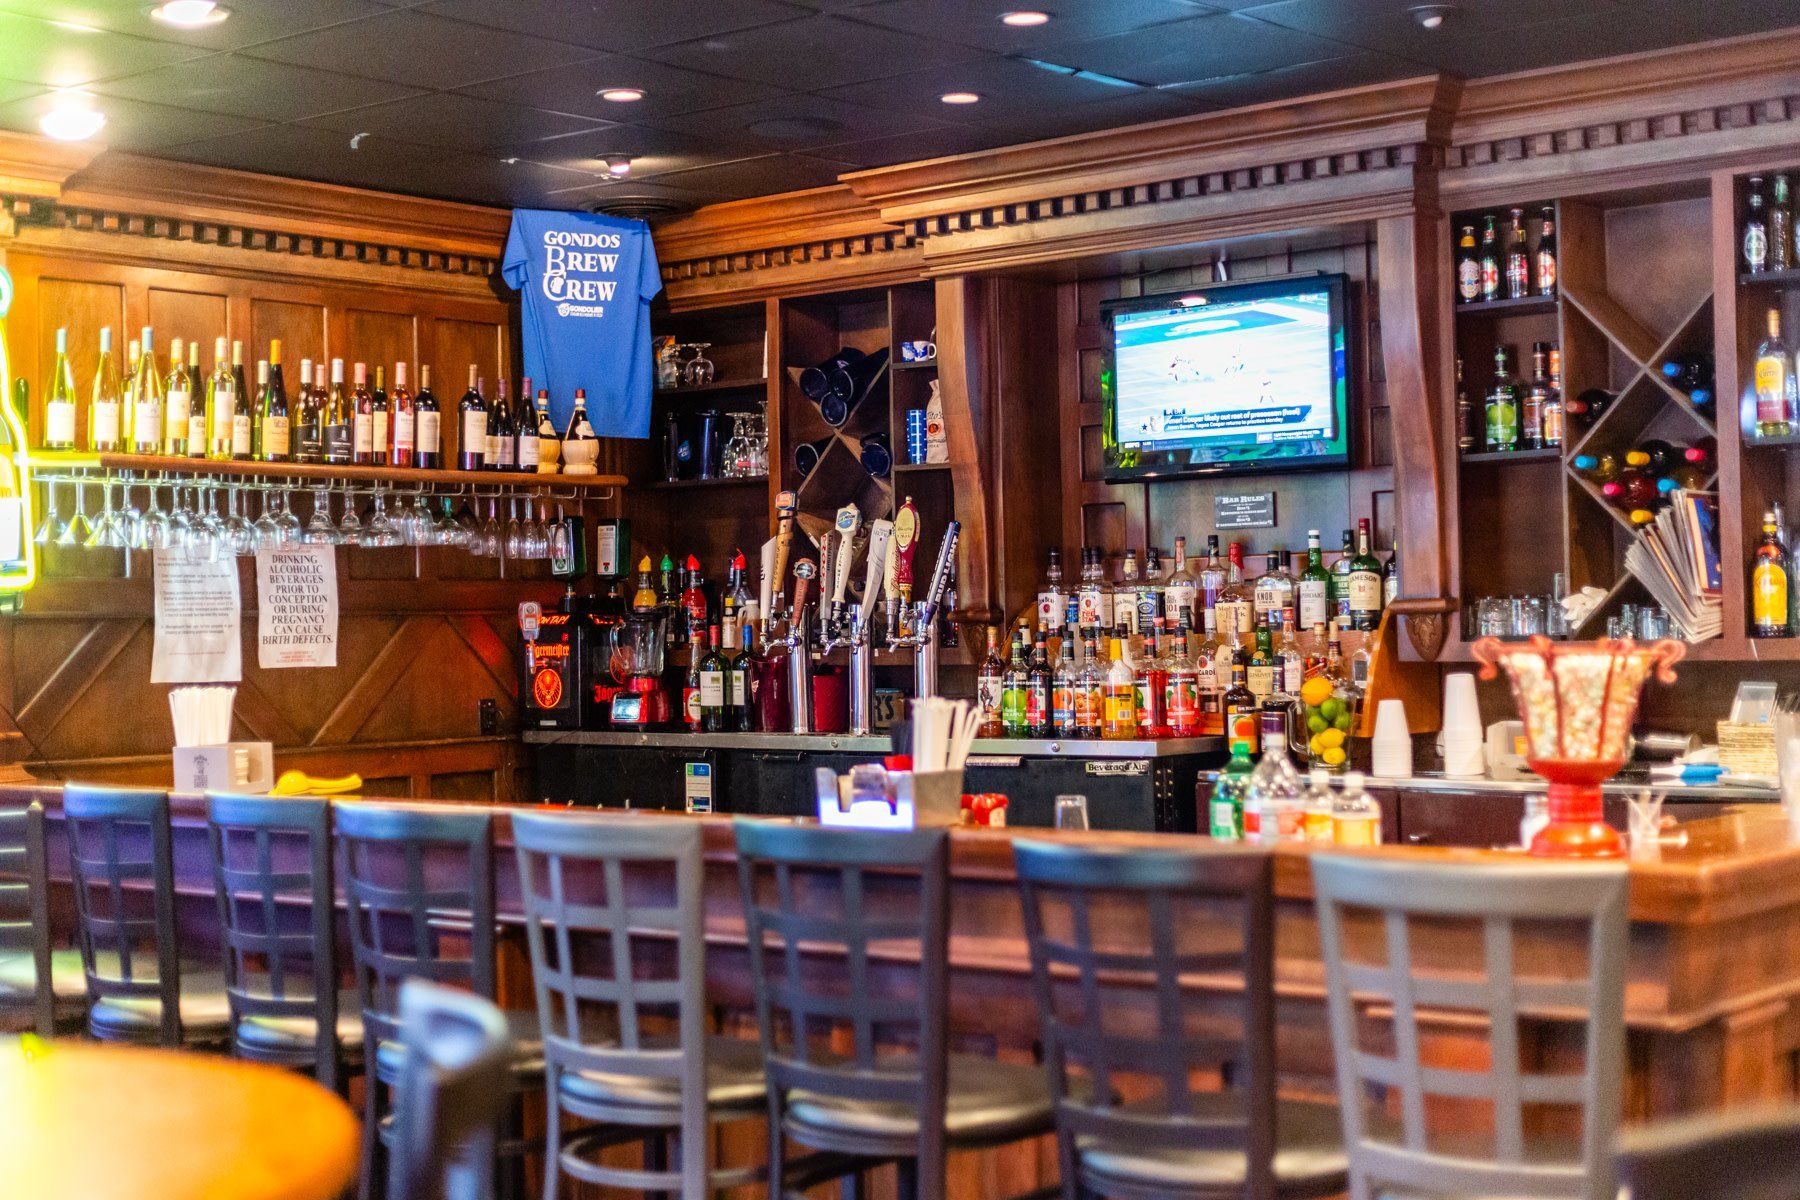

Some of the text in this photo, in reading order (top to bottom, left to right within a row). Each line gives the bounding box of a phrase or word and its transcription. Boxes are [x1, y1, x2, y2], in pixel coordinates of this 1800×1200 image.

[544, 230, 621, 248] GONDOS
[543, 245, 620, 276] BREW
[542, 269, 617, 302] CREW
[272, 554, 318, 564] DRINKING
[269, 564, 323, 574] ALCOHOLIC
[934, 534, 959, 603] BUD LIGHT
[269, 574, 324, 584] BEVERAGES
[275, 584, 319, 594] PRIOR TO
[268, 594, 328, 604] CONCEPTION
[1256, 592, 1273, 601] KNOB
[273, 604, 324, 614] OR DURING
[1166, 604, 1178, 612] 101
[271, 614, 325, 624] PREGNANCY
[550, 615, 570, 625] TAP!
[273, 624, 324, 634] CAN CAUSE
[262, 634, 333, 645] BIRTH DEFECTS.
